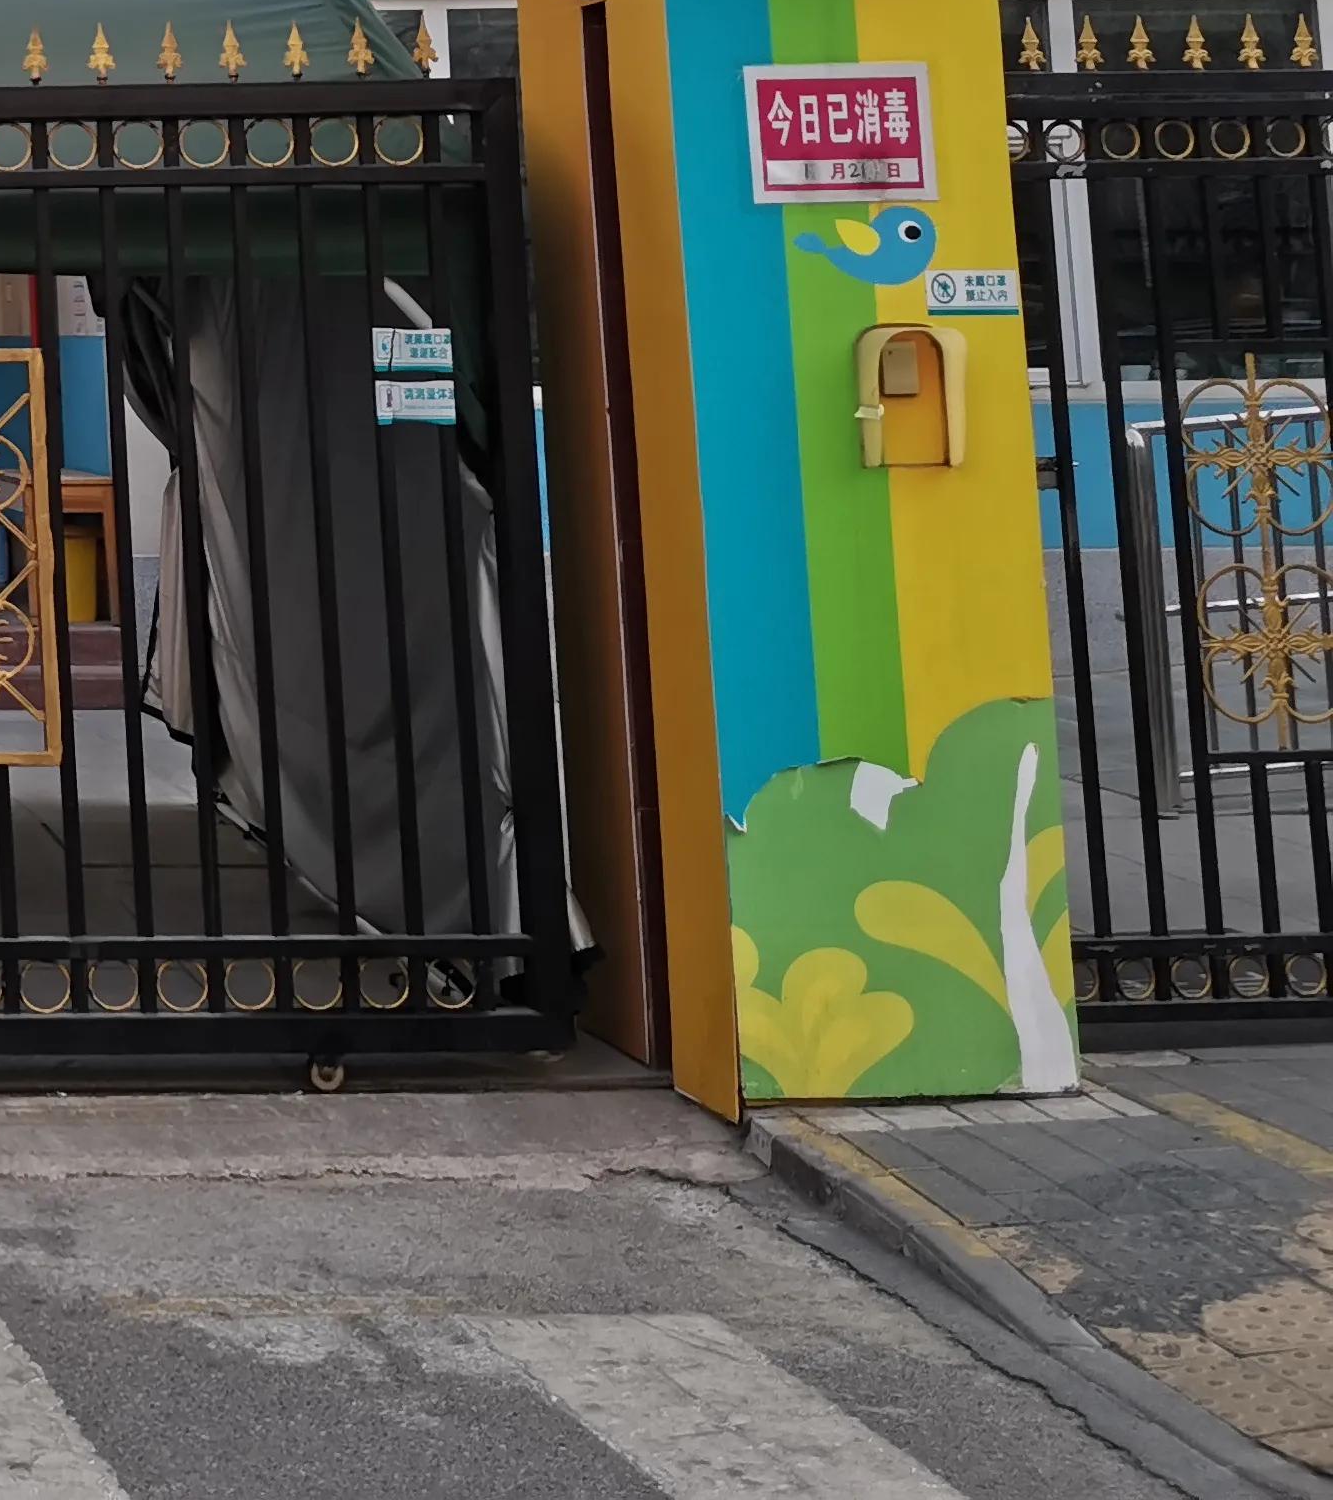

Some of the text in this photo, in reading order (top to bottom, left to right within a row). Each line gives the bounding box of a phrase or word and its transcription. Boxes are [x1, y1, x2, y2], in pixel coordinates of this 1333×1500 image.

[766, 87, 912, 147] 今日已消毒
